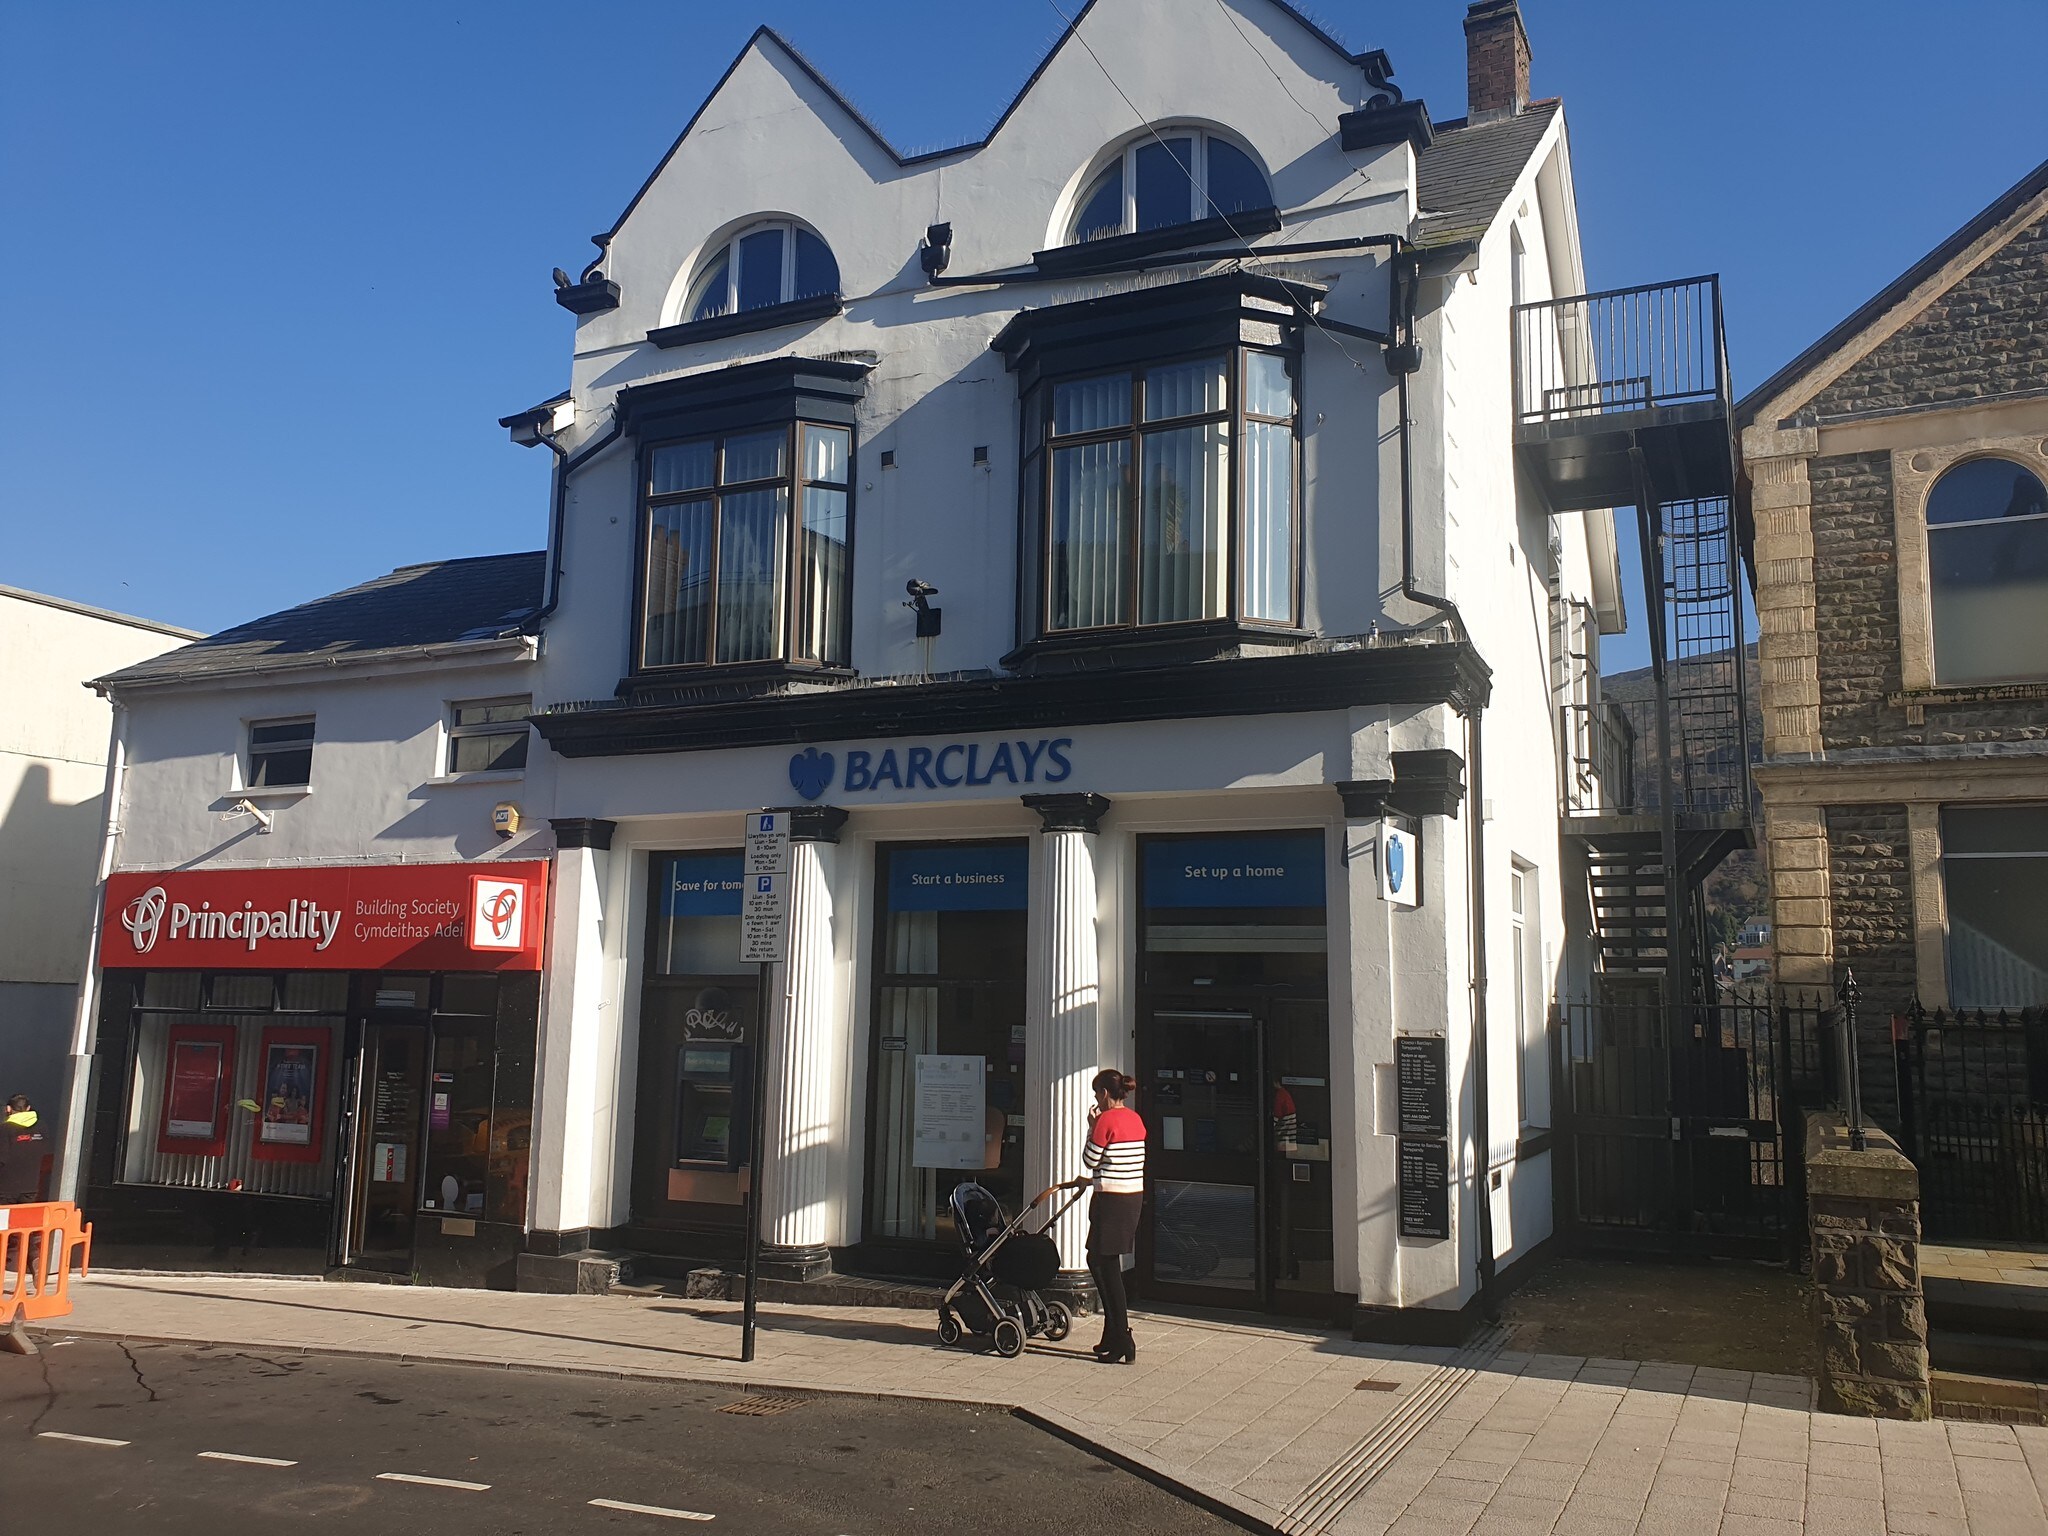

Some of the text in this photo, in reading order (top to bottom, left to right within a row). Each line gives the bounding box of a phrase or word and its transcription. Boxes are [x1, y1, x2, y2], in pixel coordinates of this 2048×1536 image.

[844, 738, 1072, 792] BARCLAYS
[496, 812, 508, 820] ADT
[912, 873, 1004, 885] Start a business
[1185, 865, 1284, 880] Set up a home
[676, 880, 744, 892] Save for tom
[761, 878, 770, 890] P
[356, 899, 460, 919] Building Society
[169, 899, 341, 950] Principality
[355, 922, 464, 942] Cymdeithas Adei
